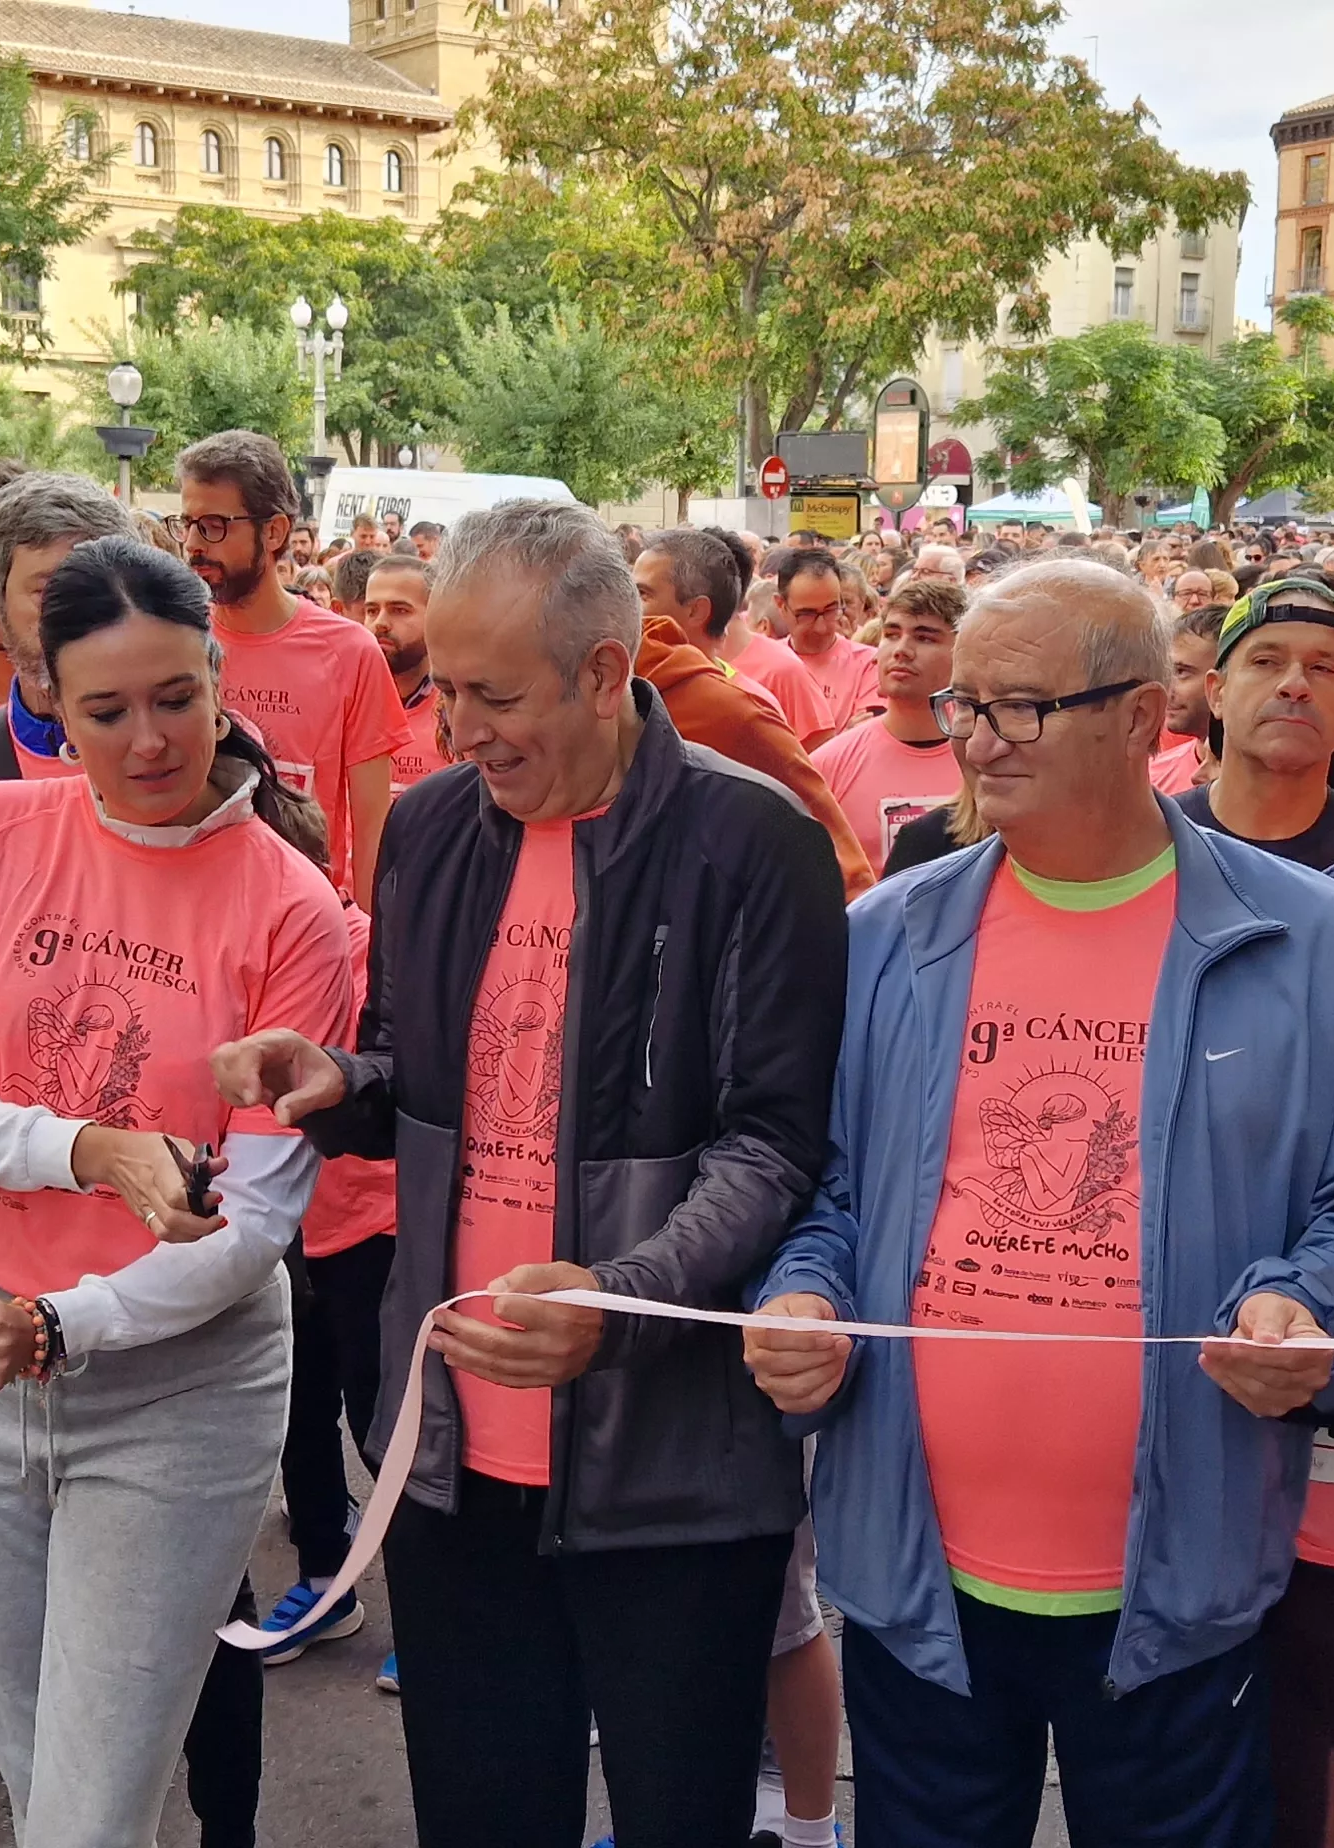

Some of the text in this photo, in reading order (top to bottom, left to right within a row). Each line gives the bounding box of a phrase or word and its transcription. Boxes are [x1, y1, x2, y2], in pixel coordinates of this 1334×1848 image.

[336, 493, 366, 517] RENT
[806, 503, 852, 515] McCrispy
[223, 685, 290, 704] CÁNCER
[255, 703, 302, 715] HUESCA
[893, 814, 920, 824] CONT
[23, 913, 68, 931] CONTRA
[506, 920, 571, 951] CÁNC
[82, 930, 185, 976] CÁNCER
[126, 964, 198, 995] HUESCA
[968, 1001, 1002, 1019] NTRA
[1093, 1045, 1147, 1063] HUE
[466, 1136, 556, 1167] QUIÉRETE MUC
[965, 1229, 1130, 1261] QUIÉRETE MUCHO
